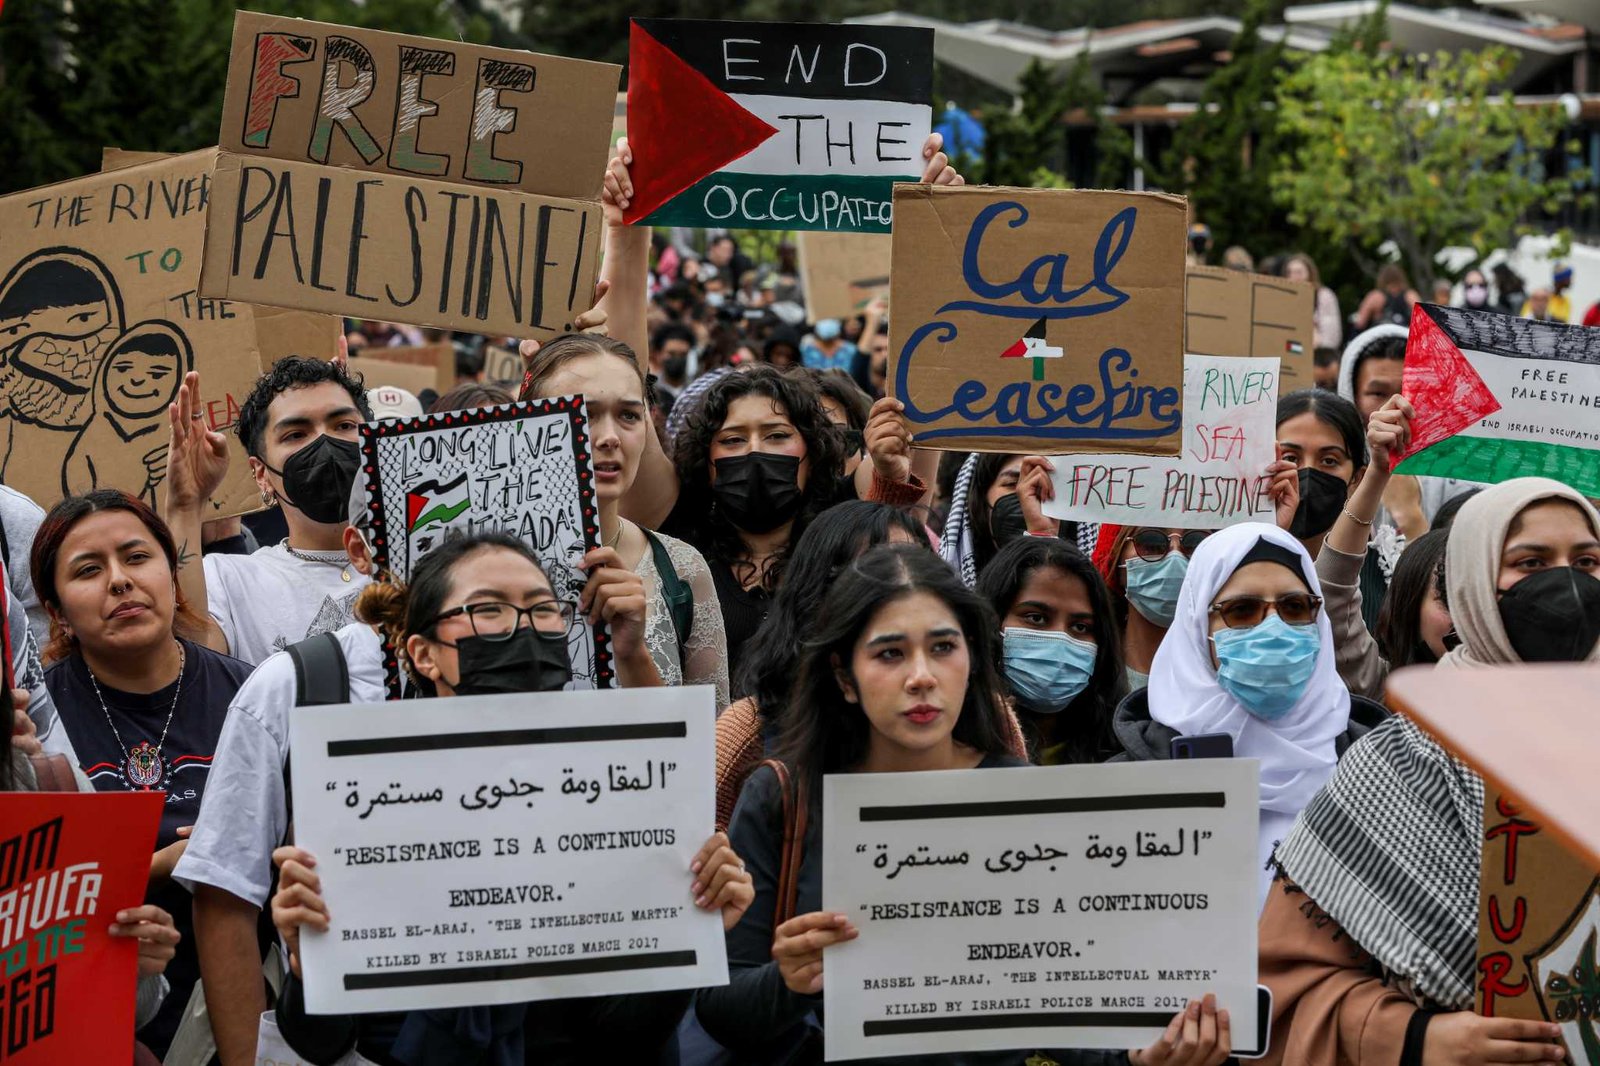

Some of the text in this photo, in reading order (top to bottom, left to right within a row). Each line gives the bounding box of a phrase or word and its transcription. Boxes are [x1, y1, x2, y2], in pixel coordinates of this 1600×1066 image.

[723, 39, 887, 87] END
[241, 32, 536, 185] FREE
[778, 114, 912, 168] THE
[28, 195, 94, 228] THE
[703, 185, 893, 230] OCCUPATIO
[125, 247, 182, 274] TO
[231, 166, 588, 332] PALESTINE!
[962, 202, 1138, 305] Cal
[170, 290, 236, 320] THE
[896, 321, 1182, 430] Ceasefire
[1201, 368, 1274, 411] RIVER
[1521, 369, 1569, 384] FREE
[207, 392, 242, 430] EA
[1511, 387, 1600, 408] PALESTINE
[1190, 424, 1246, 463] SEA
[1481, 420, 1599, 441] END ISRAELI OCCUPATIO
[402, 419, 563, 484] LONG LIVE
[475, 468, 543, 512] THE
[1067, 464, 1274, 517] FREE PALESTINE
[459, 778, 544, 811] جدوى
[493, 837, 519, 856] IS
[533, 837, 546, 854] A
[558, 829, 676, 852] CONTINUOUS
[985, 844, 1068, 873] جدوى
[1014, 898, 1040, 915] IS
[1053, 898, 1066, 913] A
[1078, 893, 1209, 912] CONTINUOUS
[342, 926, 397, 941] BASSEL
[406, 922, 475, 937] EL-ARAJ,
[531, 911, 625, 929] INTELLECTUAL
[367, 937, 659, 968] KILLED BY ISRAELI POLICE MARCH 2017
[863, 977, 915, 990] BASSEL
[924, 974, 991, 987] EL-ARAJ,
[1045, 970, 1149, 982] INTELLECTUAL
[886, 996, 1188, 1015] KILLED BY ISRAELI POLICE MARCH 2017
